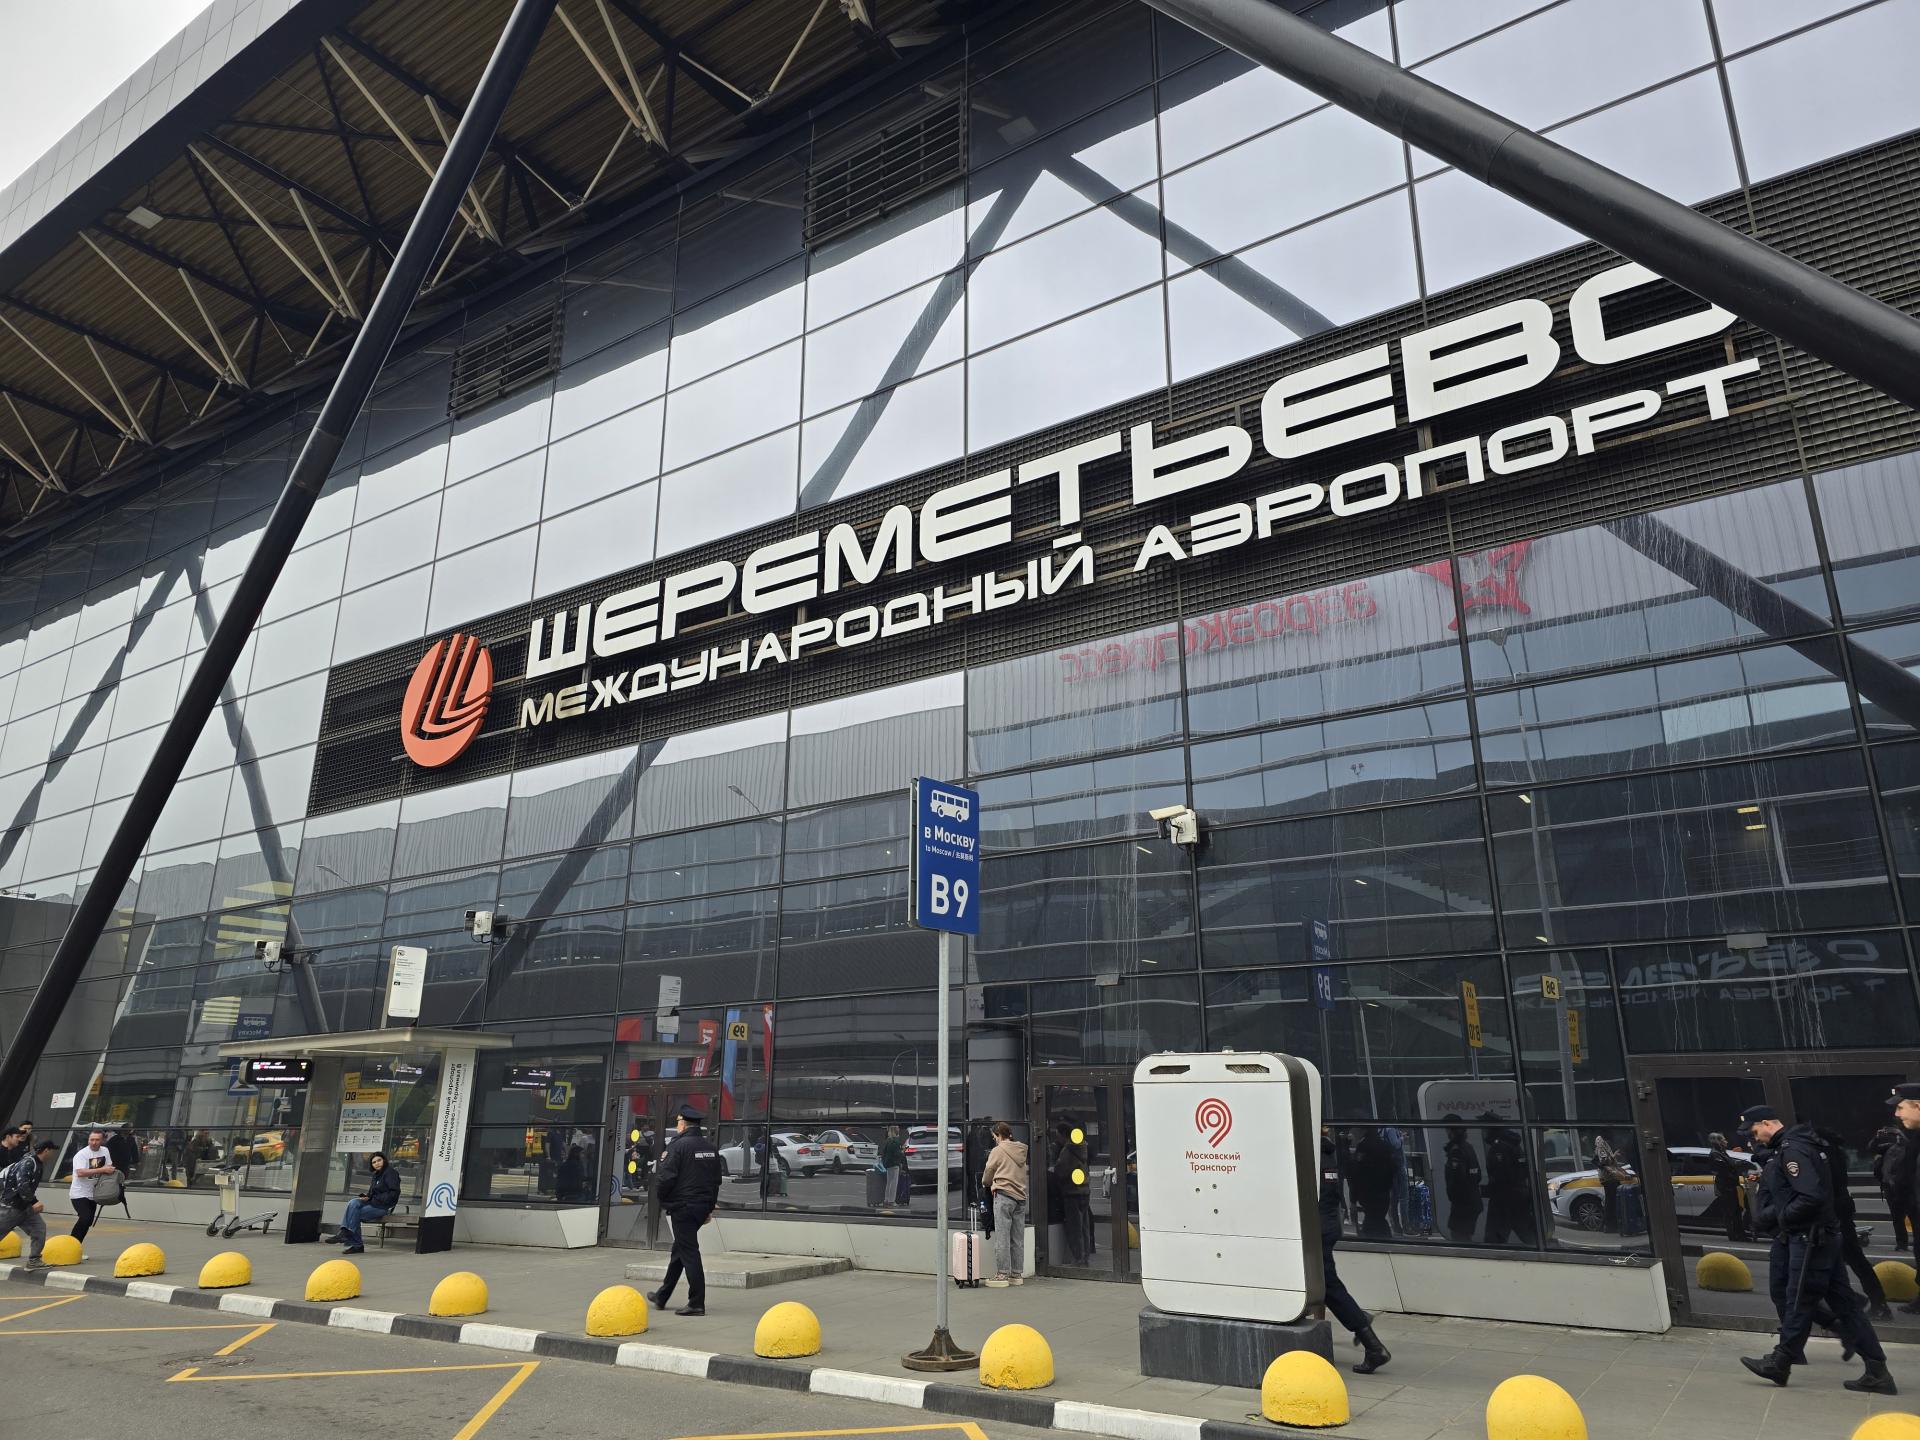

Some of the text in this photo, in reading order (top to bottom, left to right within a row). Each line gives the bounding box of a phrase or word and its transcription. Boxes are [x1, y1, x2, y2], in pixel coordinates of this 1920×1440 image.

[526, 262, 1738, 680] ШЕРЕМЕТЬЕВО
[520, 357, 1761, 730] МЕЖДУНАРОДНЫЙ АЭРОПОРТ
[924, 825, 975, 852] в Москву
[931, 845, 951, 857] Moscow
[931, 873, 969, 918] B9
[1185, 1150, 1241, 1161] Московский
[1189, 1161, 1237, 1174] Транспорт
